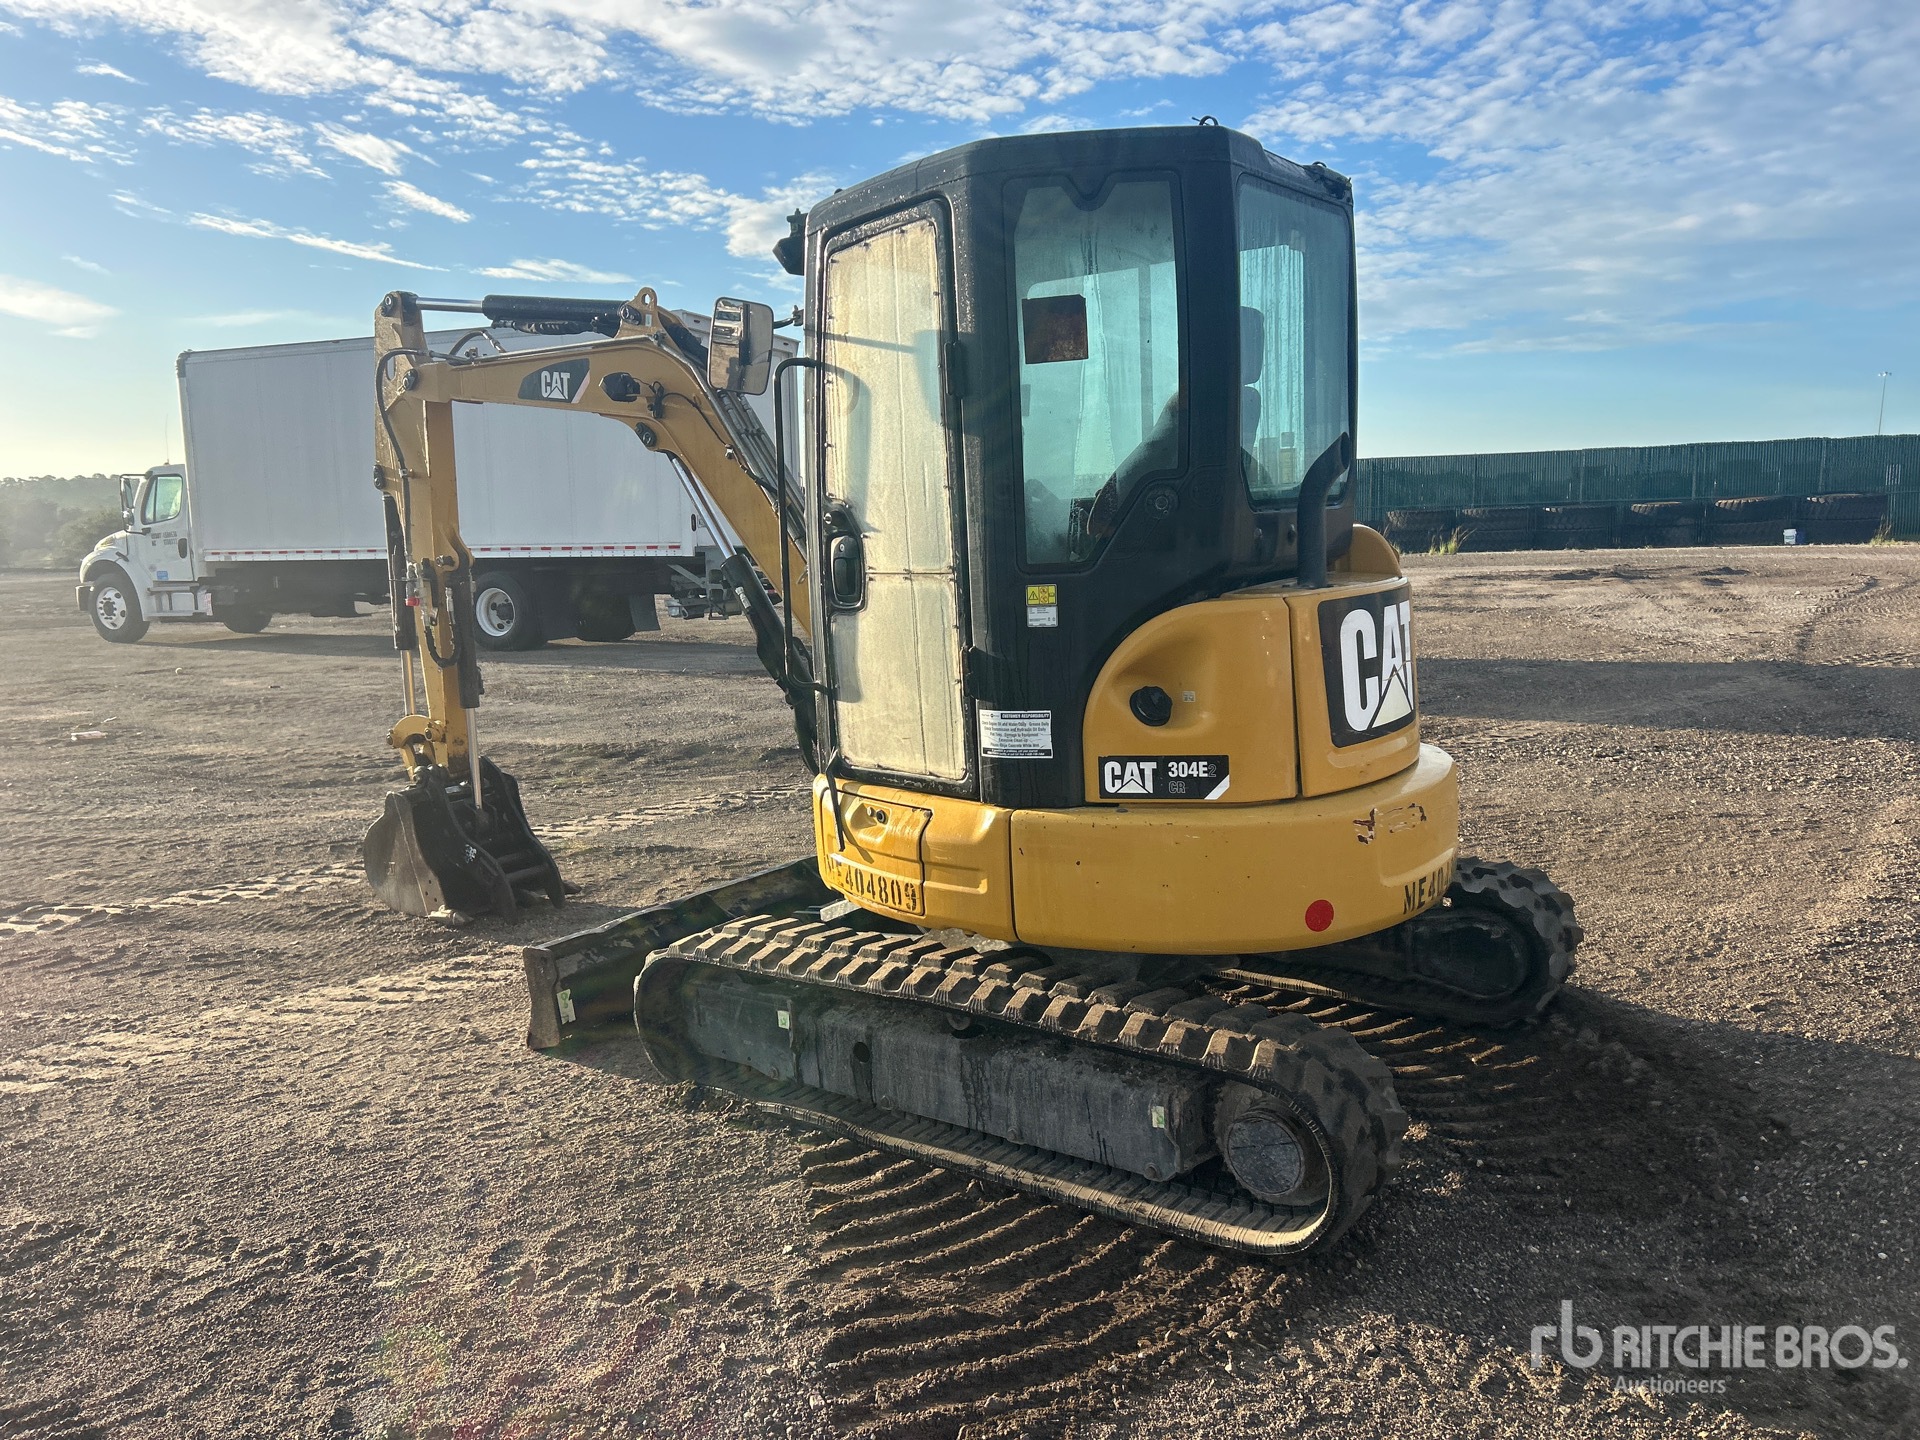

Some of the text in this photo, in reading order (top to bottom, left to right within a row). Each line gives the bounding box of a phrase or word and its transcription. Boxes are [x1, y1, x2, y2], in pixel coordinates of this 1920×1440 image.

[541, 371, 570, 399] CAT
[1340, 599, 1414, 732] CAT
[1104, 761, 1157, 794] CAT
[1168, 780, 1186, 794] CR
